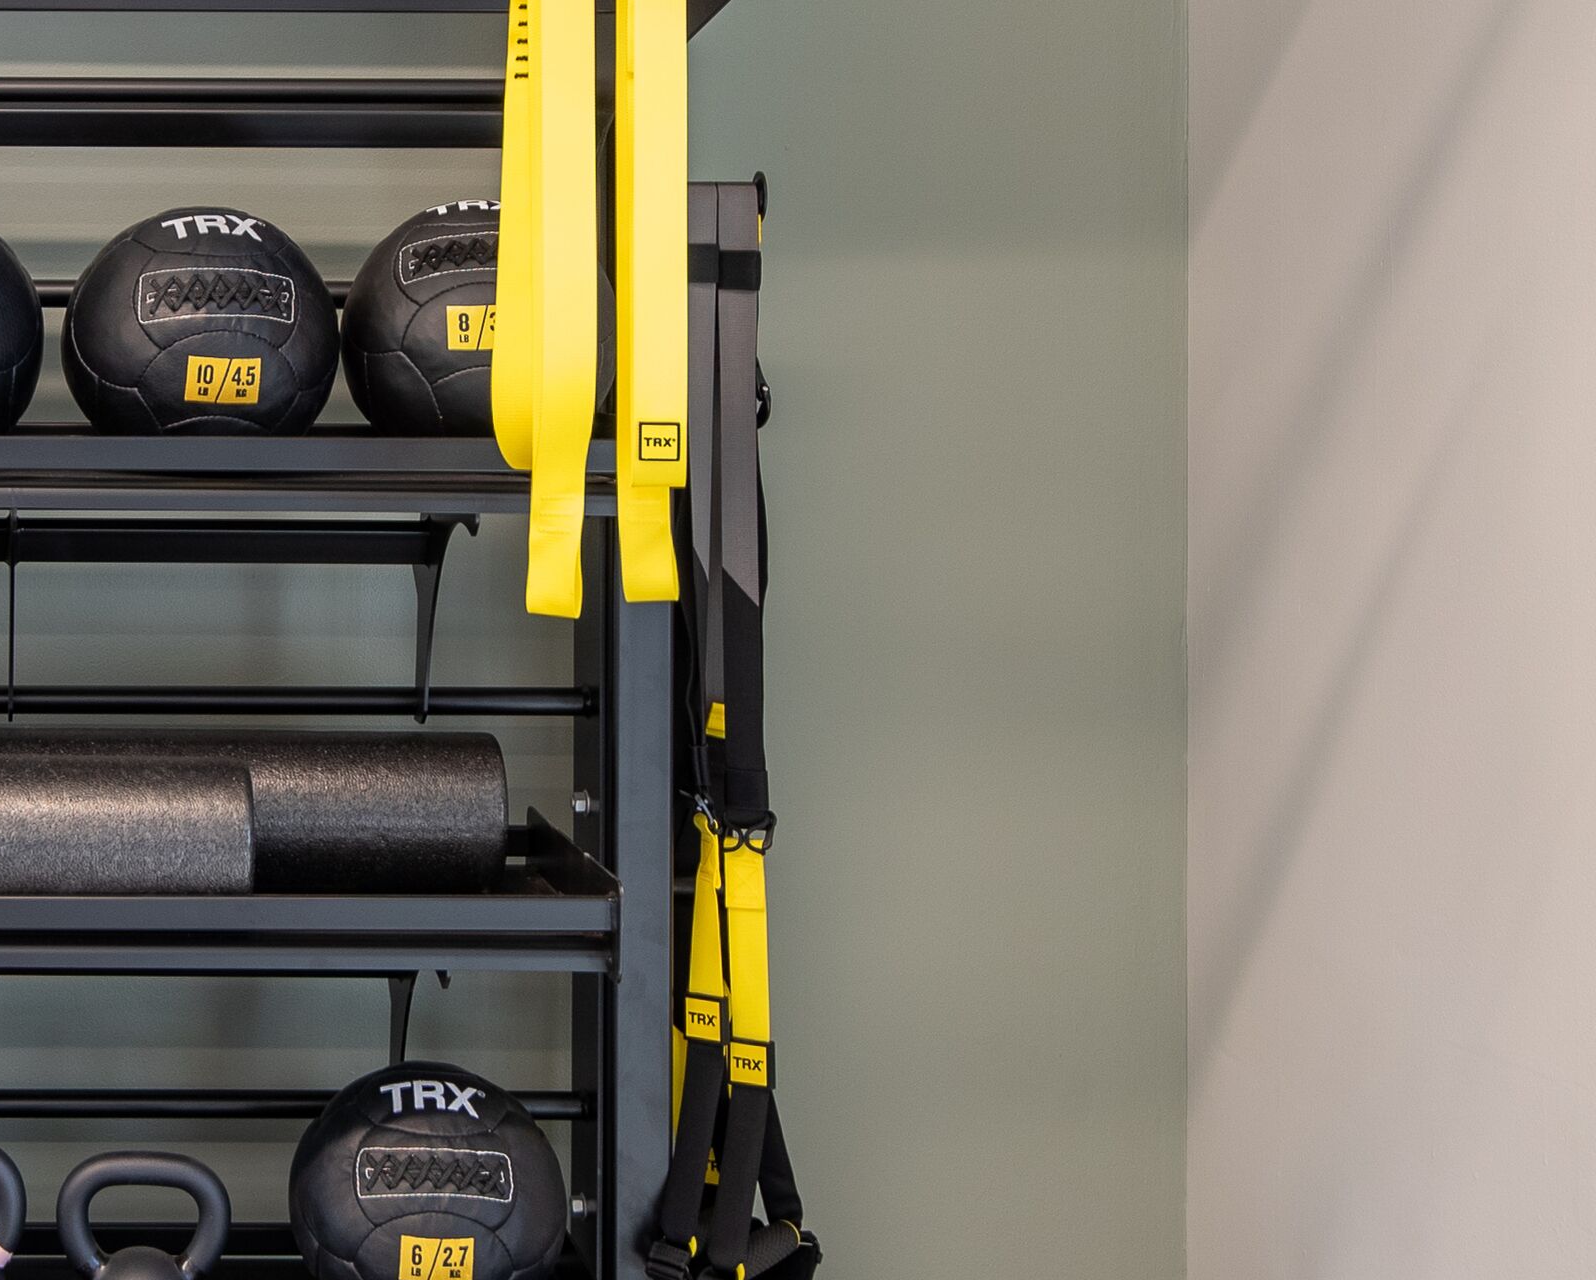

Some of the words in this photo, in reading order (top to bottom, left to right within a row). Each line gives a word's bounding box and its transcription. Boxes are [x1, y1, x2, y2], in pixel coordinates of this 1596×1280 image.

[425, 200, 500, 216] TR
[161, 214, 263, 241] TRX
[458, 313, 470, 332] 8
[459, 334, 470, 343] LB
[197, 365, 214, 384] 10
[232, 366, 256, 386] 4.5
[198, 387, 209, 396] LB
[236, 389, 247, 397] KG
[644, 437, 672, 447] TRX
[689, 1011, 716, 1027] TRX
[733, 1056, 762, 1072] TRX
[380, 1081, 479, 1118] TRX
[412, 1245, 422, 1265] 6
[443, 1246, 469, 1267] 2.7
[411, 1267, 421, 1277] LB
[450, 1269, 461, 1278] KG
